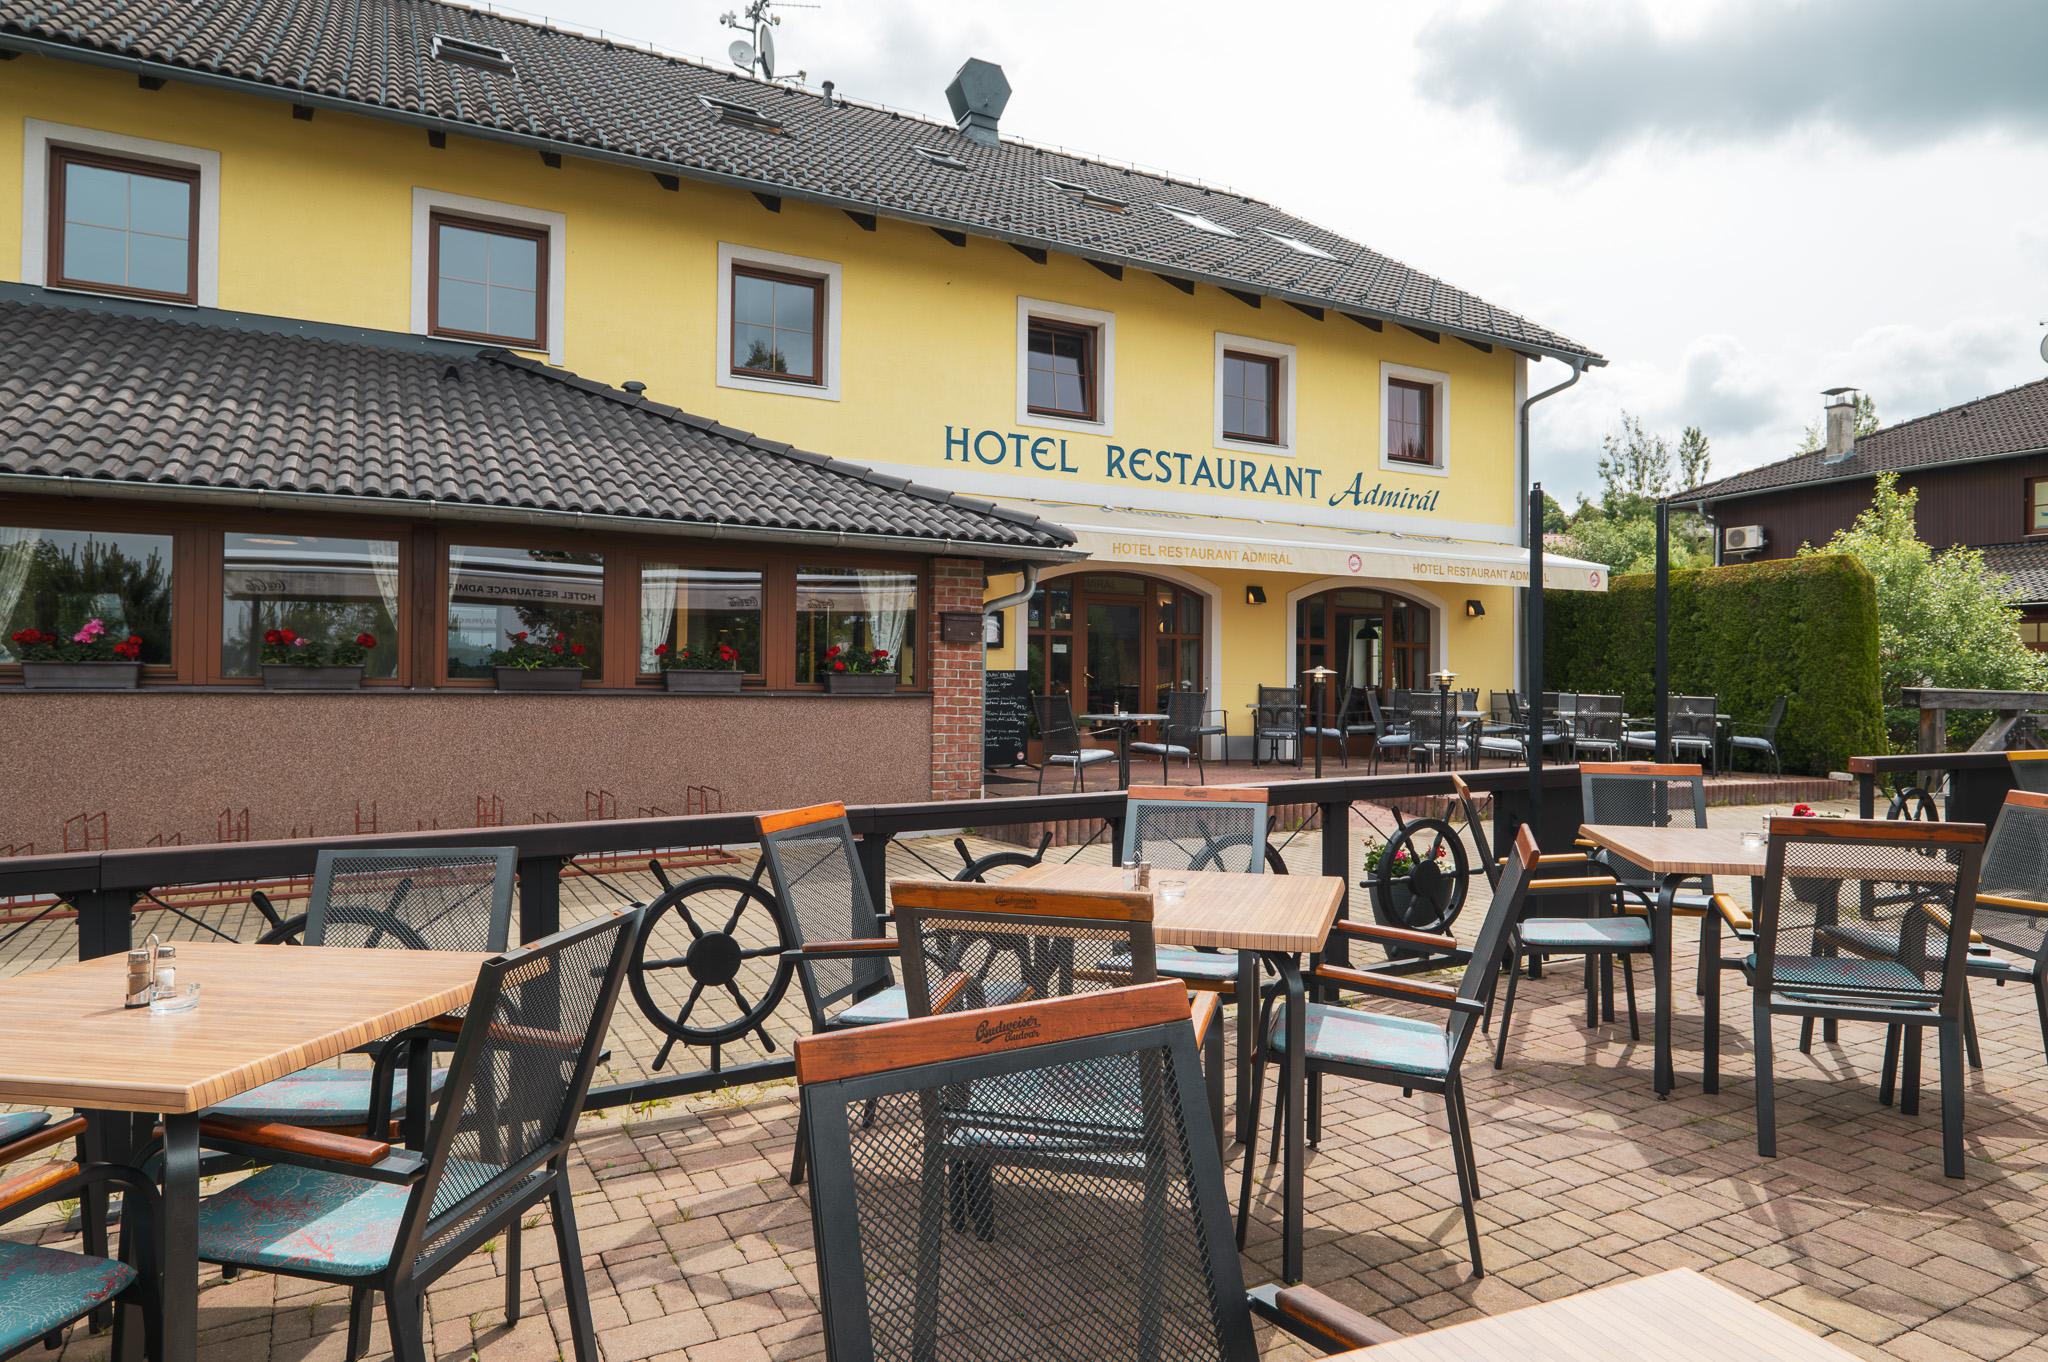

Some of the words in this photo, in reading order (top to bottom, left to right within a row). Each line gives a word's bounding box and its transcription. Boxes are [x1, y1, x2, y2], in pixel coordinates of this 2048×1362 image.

[944, 425, 1079, 473] HOTEL
[1106, 444, 1322, 499] RESTAURANT
[1329, 472, 1440, 512] Admirál
[1112, 542, 1155, 557] HOTEL
[1158, 545, 1239, 561] RESTAURANT
[1242, 550, 1293, 565] ADMIRÁL
[1413, 563, 1445, 576] HOTEL
[1447, 565, 1508, 580] RESTAURANT
